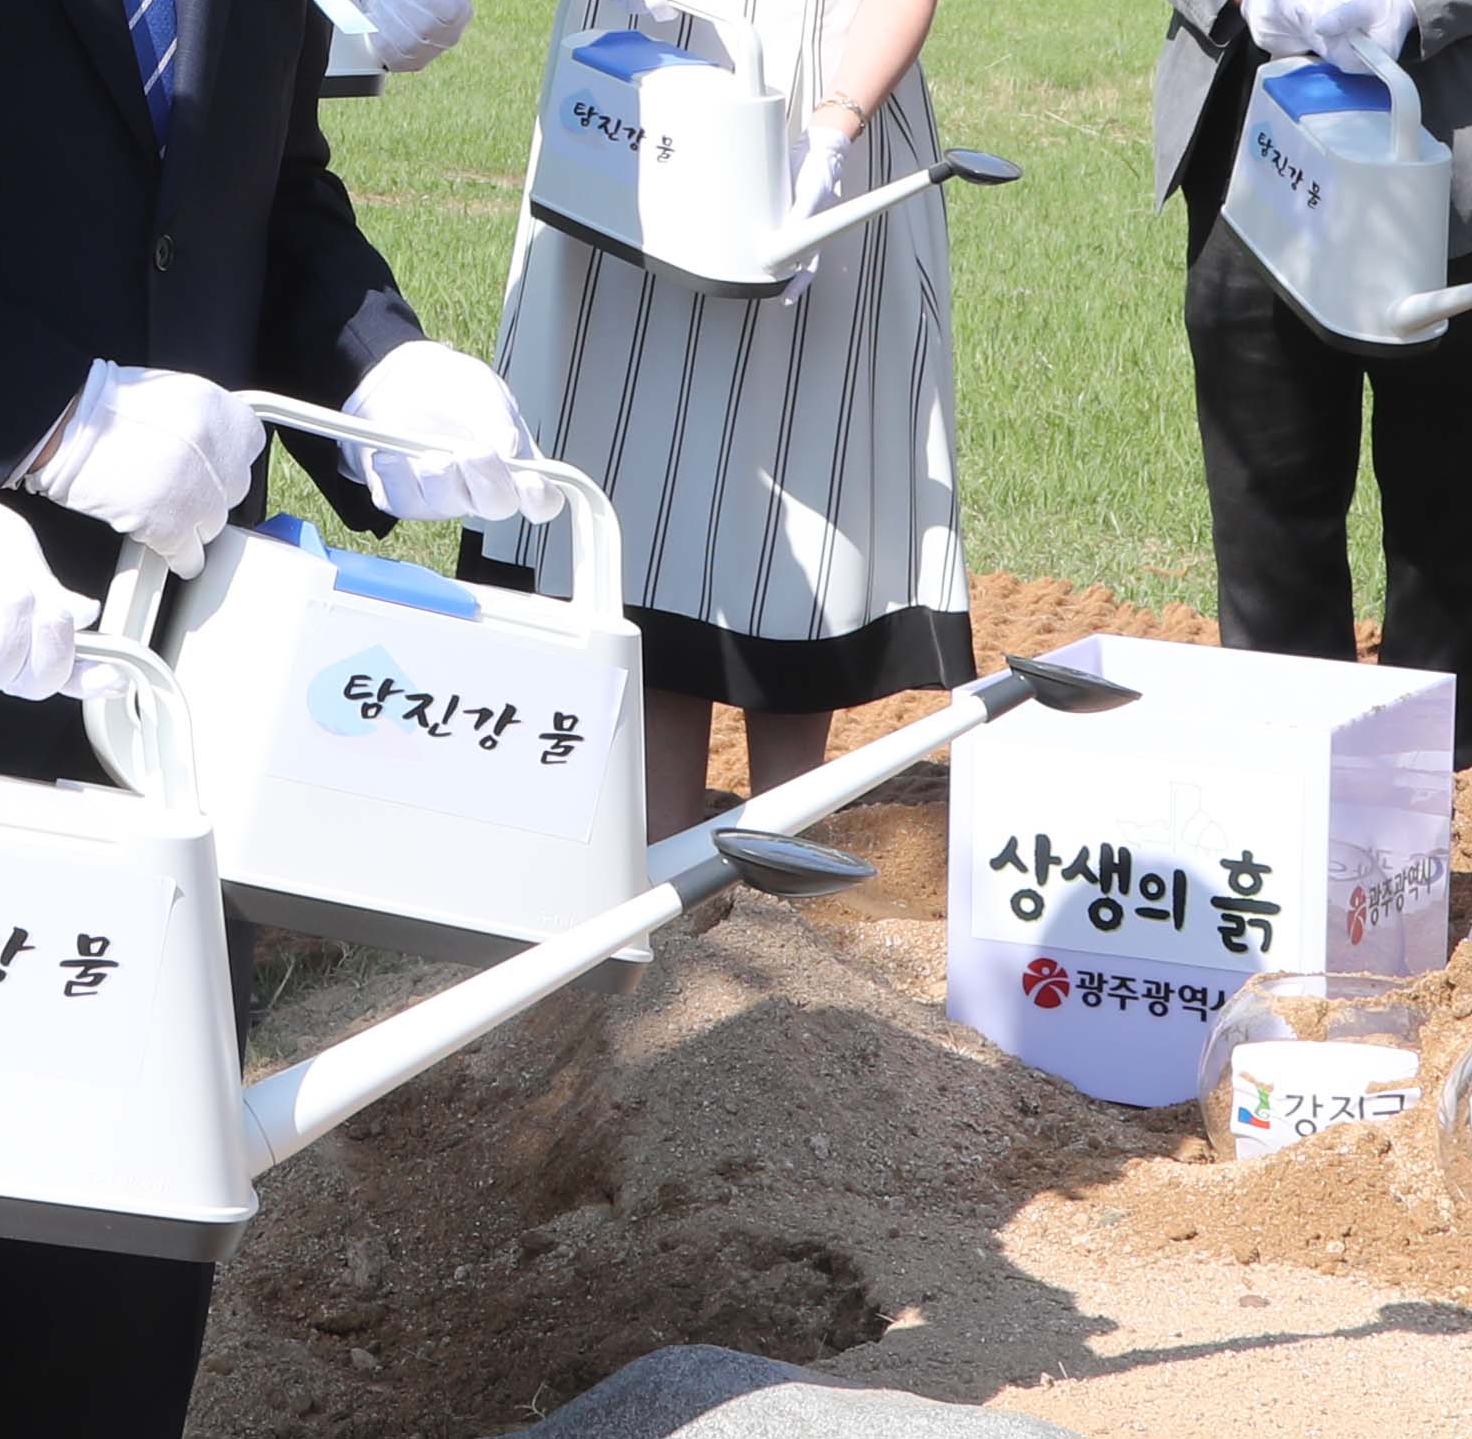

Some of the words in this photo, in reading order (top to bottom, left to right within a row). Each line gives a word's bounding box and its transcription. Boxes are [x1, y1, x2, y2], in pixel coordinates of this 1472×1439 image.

[573, 101, 647, 151] 탐진강
[656, 134, 676, 163] 물
[1257, 131, 1304, 191] 탐진강
[1307, 180, 1322, 210] 물
[343, 674, 522, 751] 탐진강
[538, 711, 585, 765] 물
[989, 833, 1187, 932] 상생의
[1210, 850, 1281, 953] 흙
[59, 933, 119, 997] 물
